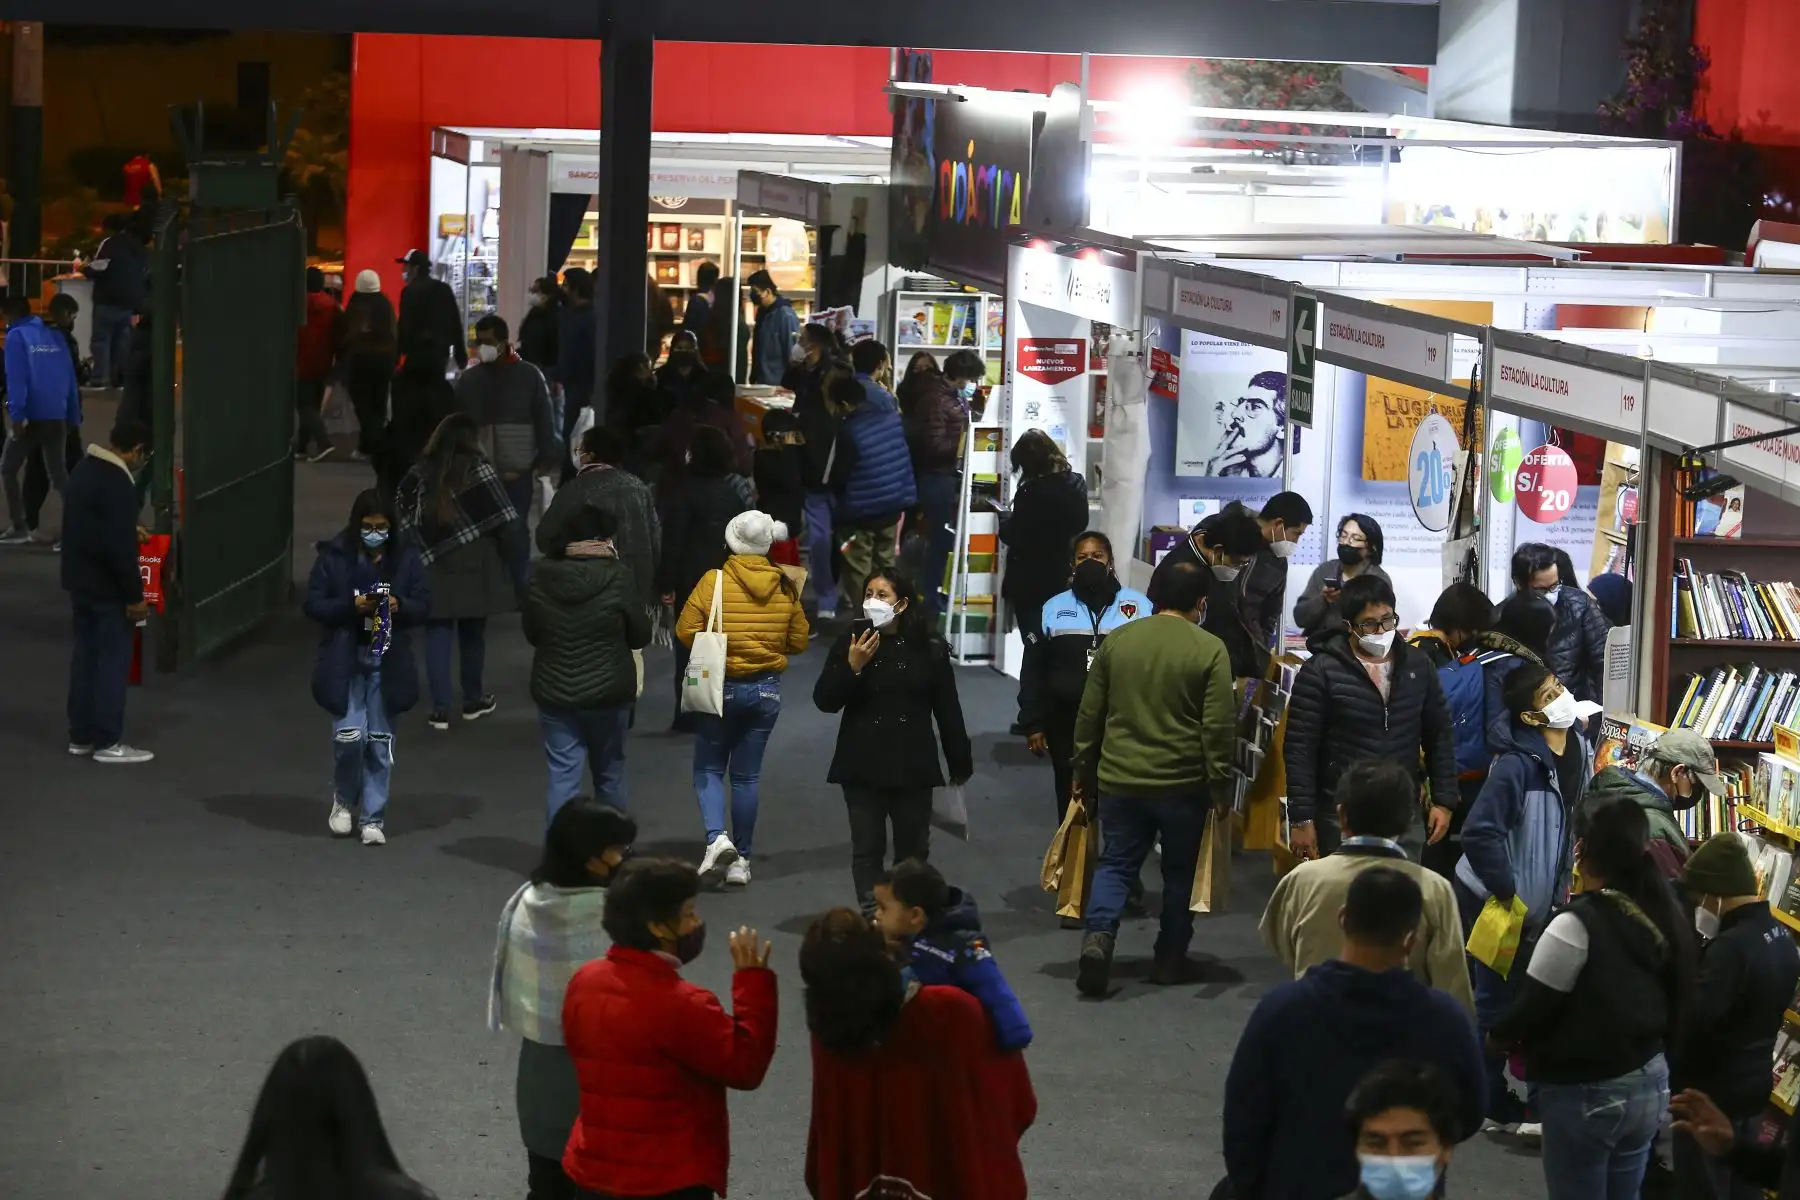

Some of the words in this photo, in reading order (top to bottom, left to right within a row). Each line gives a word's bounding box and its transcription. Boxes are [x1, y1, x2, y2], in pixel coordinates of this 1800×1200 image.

[1272, 309, 1281, 323] 119
[1329, 322, 1354, 341] ESTACIÓN
[1354, 329, 1362, 343] LA
[1362, 331, 1385, 349] CULTURA
[1427, 347, 1437, 362] 119
[1500, 364, 1530, 387] ESTACIÓN
[1530, 373, 1540, 389] LA
[1540, 375, 1569, 397] CULTURA
[1623, 394, 1635, 411] 119
[1525, 454, 1571, 466] OFERTA
[1517, 472, 1543, 492] S/.
[1540, 490, 1570, 511] 20
[1601, 719, 1628, 741] Sopas
